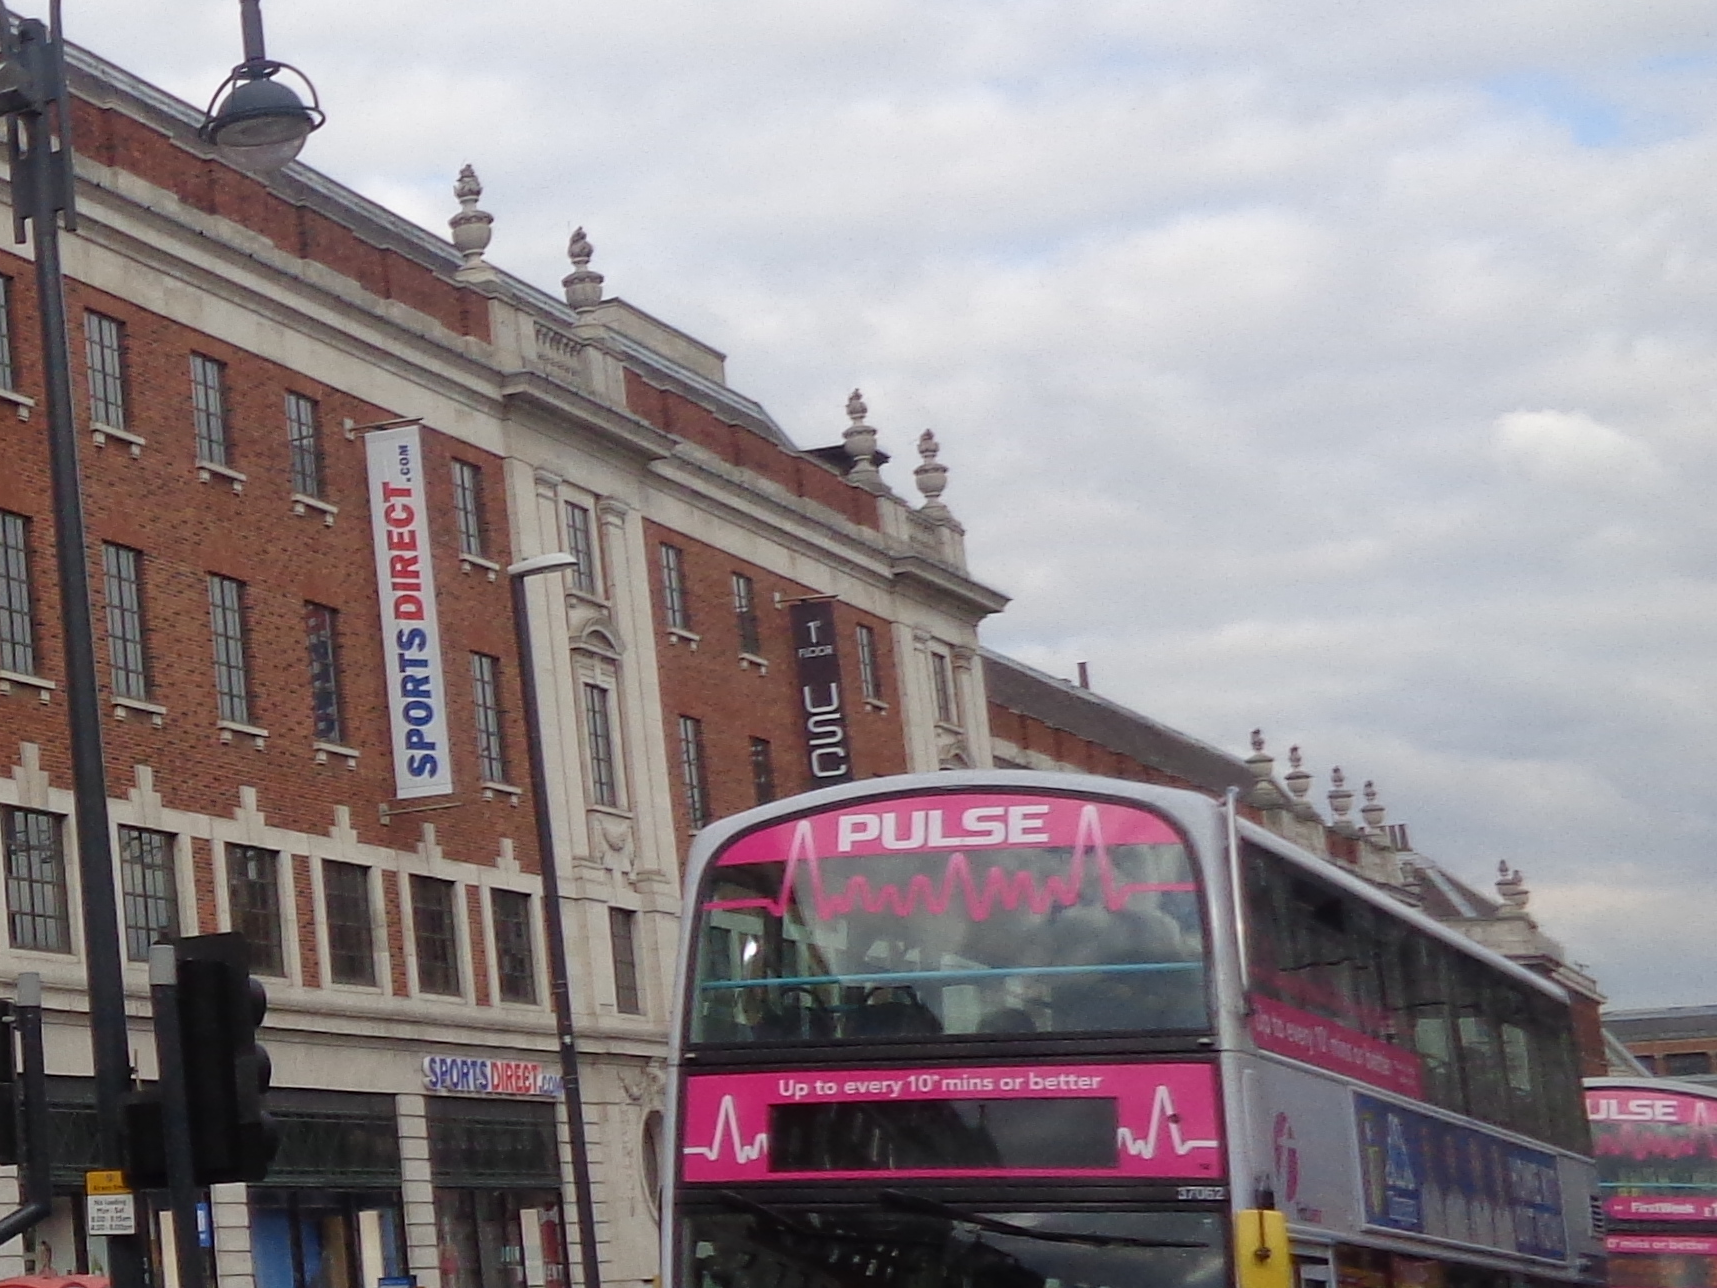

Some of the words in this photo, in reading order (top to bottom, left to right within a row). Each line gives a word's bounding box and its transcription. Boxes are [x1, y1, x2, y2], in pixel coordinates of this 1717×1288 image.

[798, 645, 833, 658] FLOOR
[838, 805, 1049, 852] PULSE
[779, 1080, 808, 1098] Up
[815, 1079, 837, 1096] to
[844, 1079, 903, 1098] every
[941, 1074, 993, 1092] mins
[1000, 1076, 1025, 1091] or
[1029, 1072, 1104, 1091] better
[1586, 1099, 1679, 1122] ULSE
[1177, 1186, 1225, 1201] 37062
